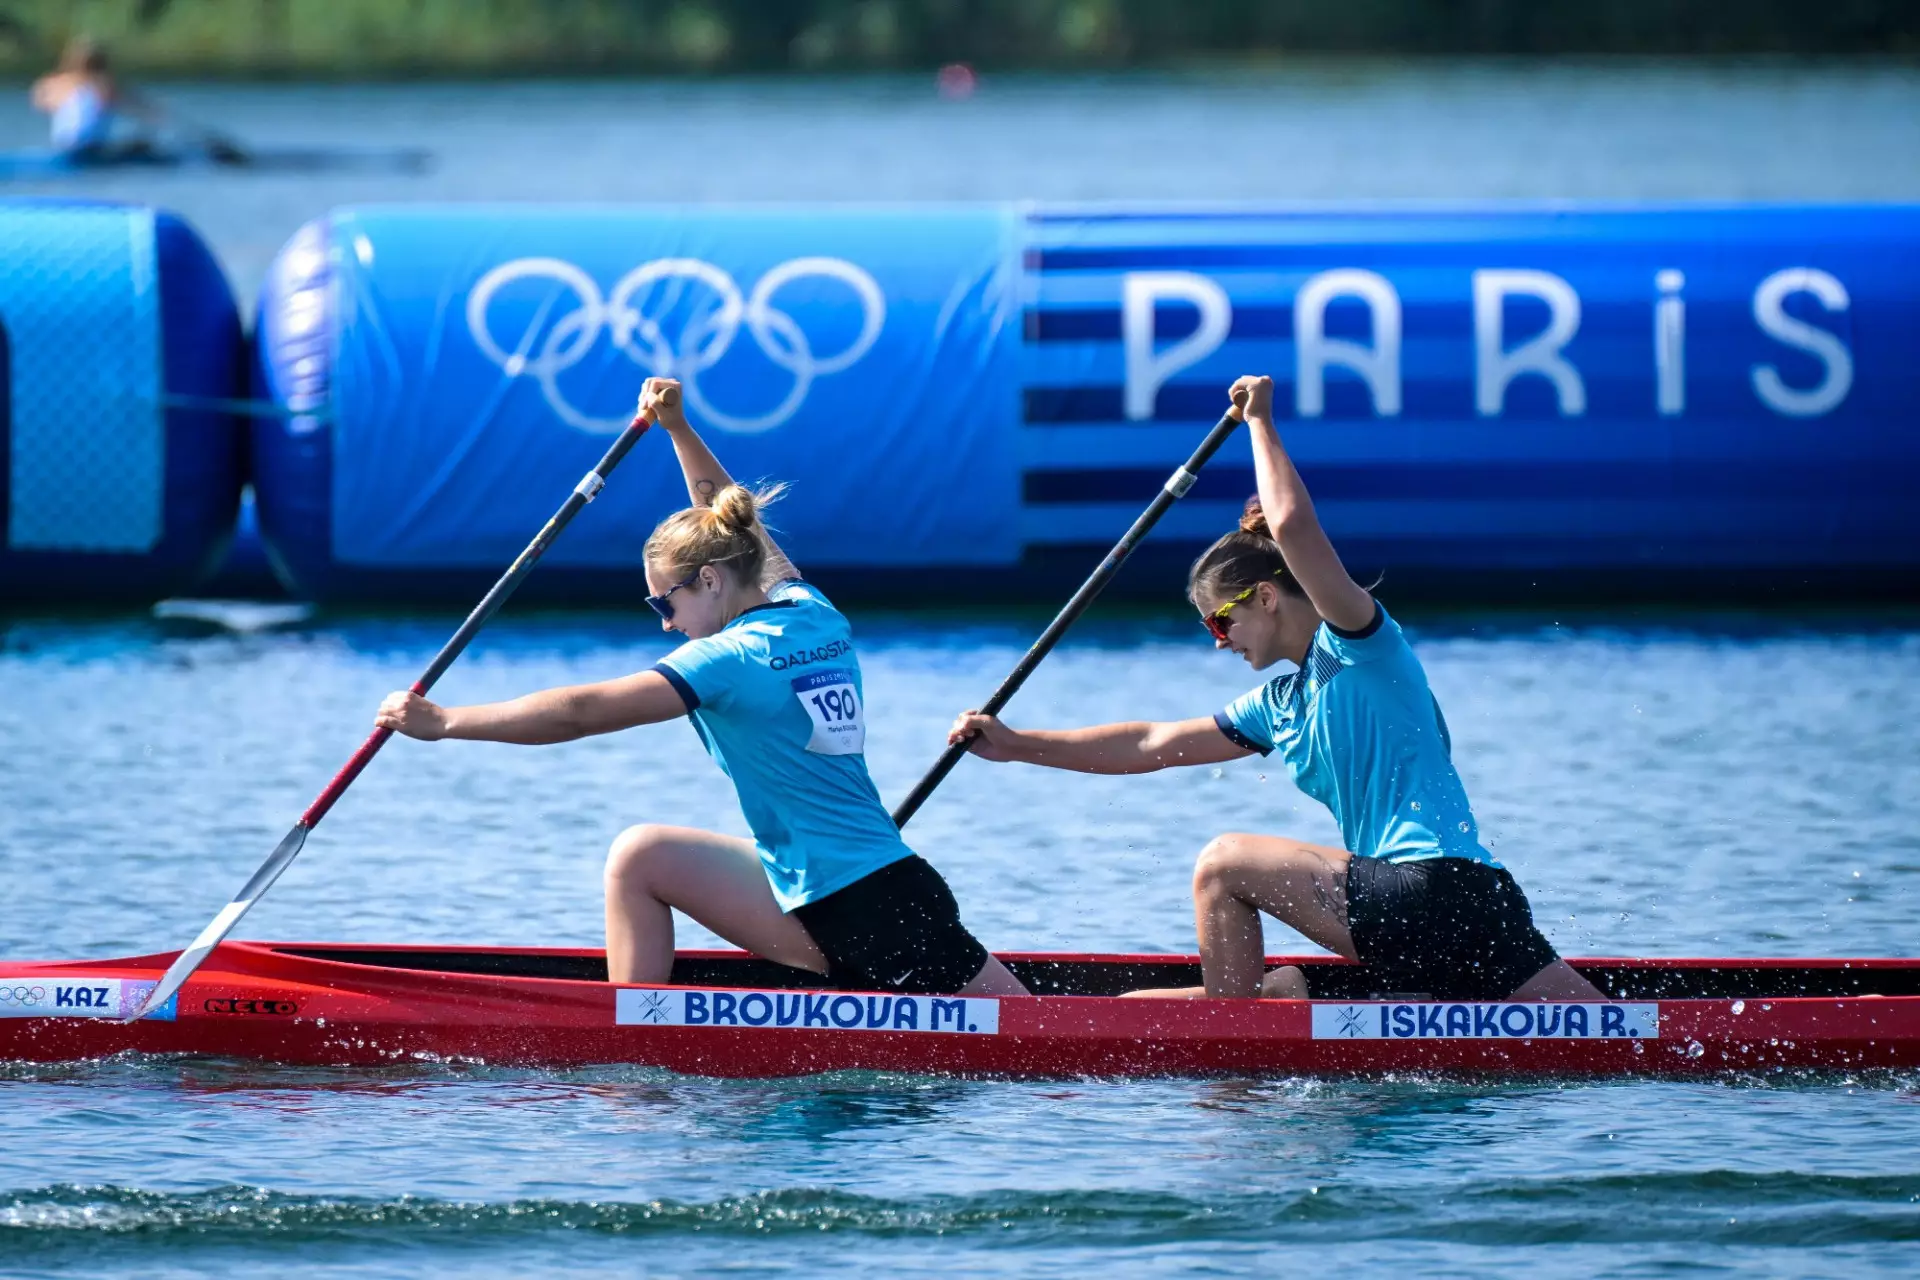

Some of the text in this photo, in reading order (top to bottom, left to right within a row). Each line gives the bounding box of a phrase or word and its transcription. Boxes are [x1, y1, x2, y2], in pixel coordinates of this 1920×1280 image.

[811, 688, 856, 722] 190
[56, 986, 110, 1007] KAZ
[208, 999, 298, 1014] NELO
[684, 992, 978, 1032] BROVKOVA M.
[1381, 1005, 1639, 1038] ISKAKOVA R.
